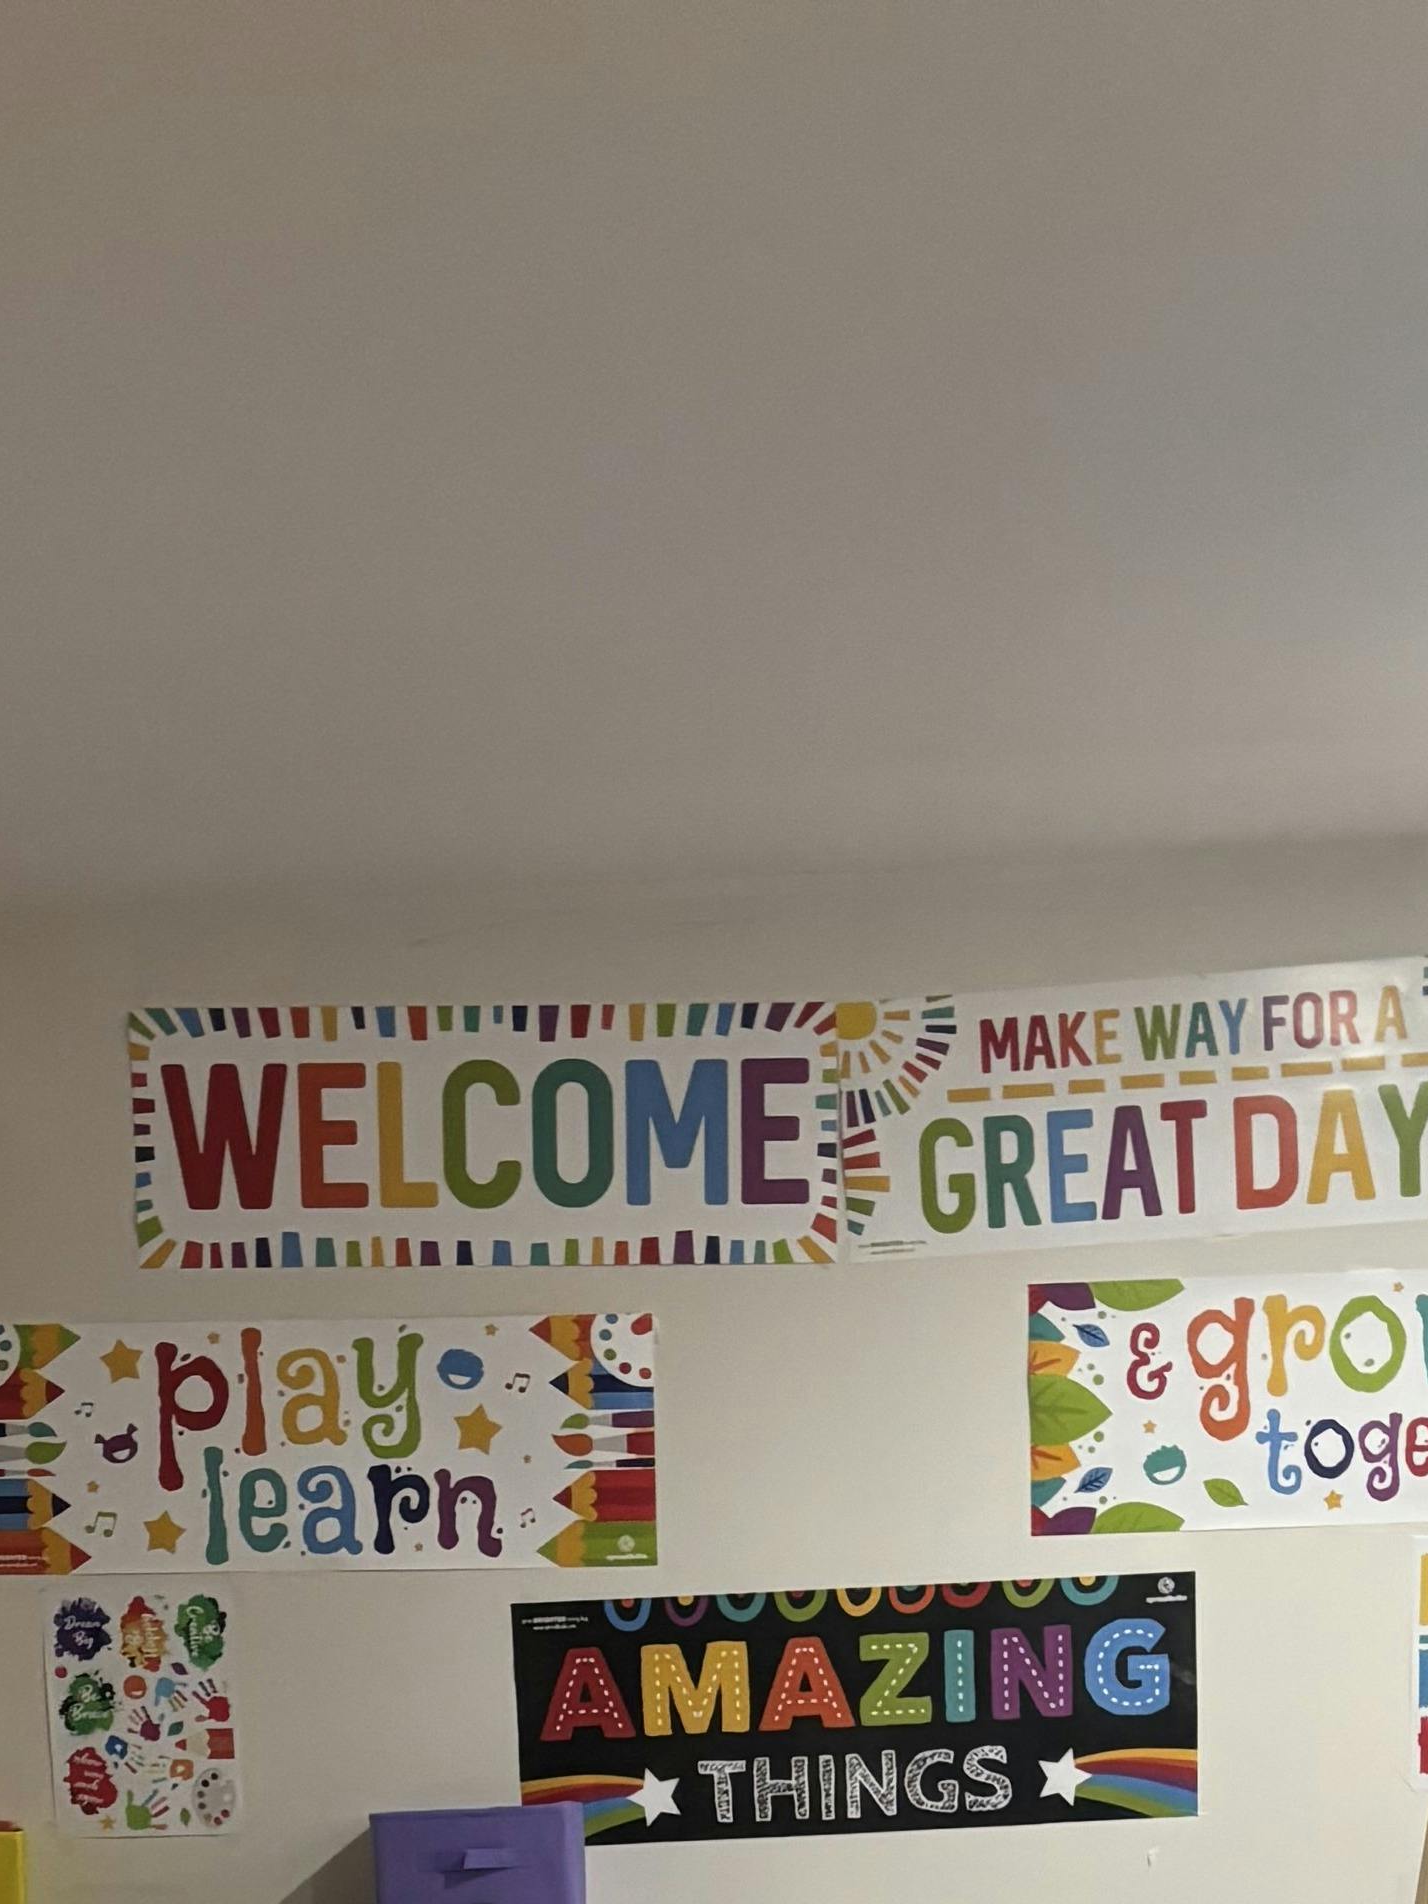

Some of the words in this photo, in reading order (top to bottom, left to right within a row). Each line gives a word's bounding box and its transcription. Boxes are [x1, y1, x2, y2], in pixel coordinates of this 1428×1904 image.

[979, 1008, 1122, 1074] MAKE
[1134, 998, 1247, 1061] WAY
[1262, 989, 1360, 1051] FOR
[1375, 985, 1408, 1043] A
[161, 1058, 810, 1210] WELCOME
[918, 1099, 1208, 1234] GREAT
[154, 1327, 424, 1492] play
[1126, 1322, 1173, 1401] &
[202, 1445, 503, 1566] learn
[540, 1617, 1170, 1742] AMAZING
[697, 1744, 1013, 1823] THINGS
